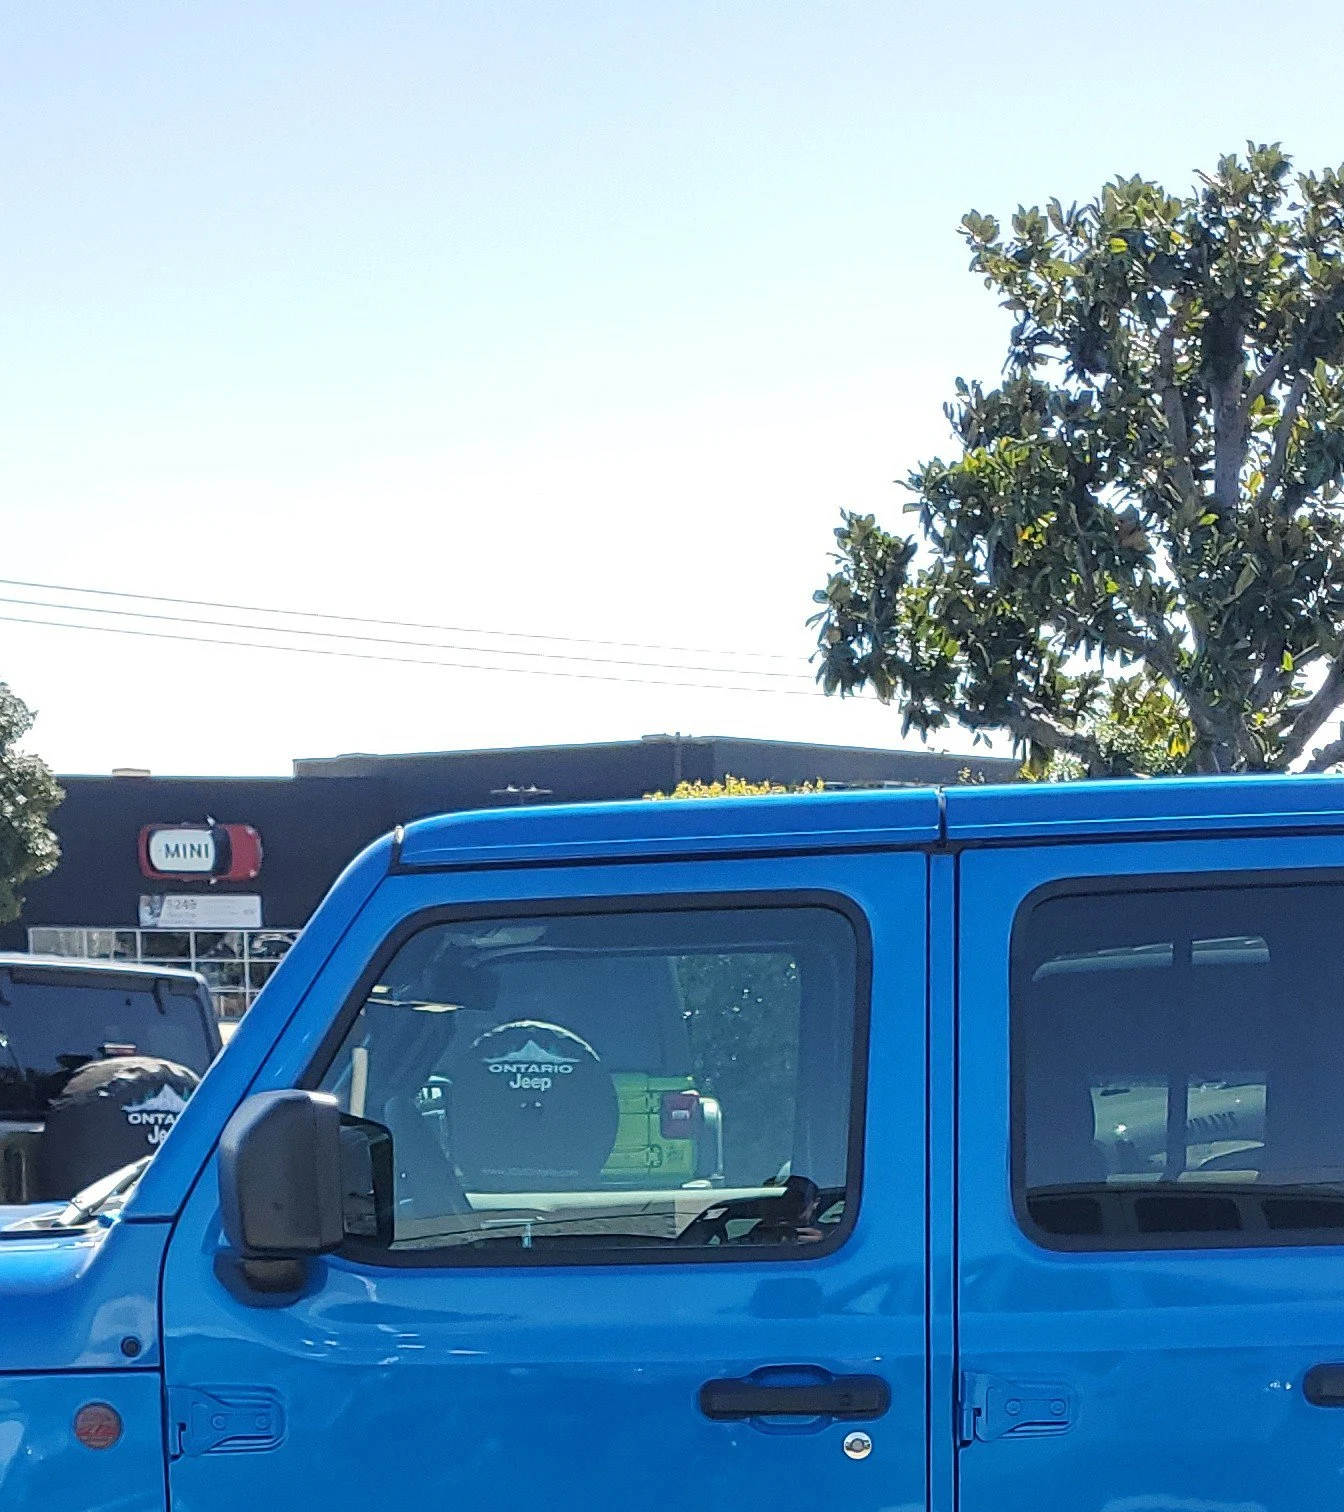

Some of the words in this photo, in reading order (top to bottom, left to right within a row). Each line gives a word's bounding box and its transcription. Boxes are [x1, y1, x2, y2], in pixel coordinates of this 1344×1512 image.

[164, 843, 210, 859] MINI
[488, 1063, 574, 1074] ONTARIO
[509, 1073, 553, 1092] Jeep
[128, 1112, 176, 1125] ONTA
[147, 1125, 169, 1145] Je
